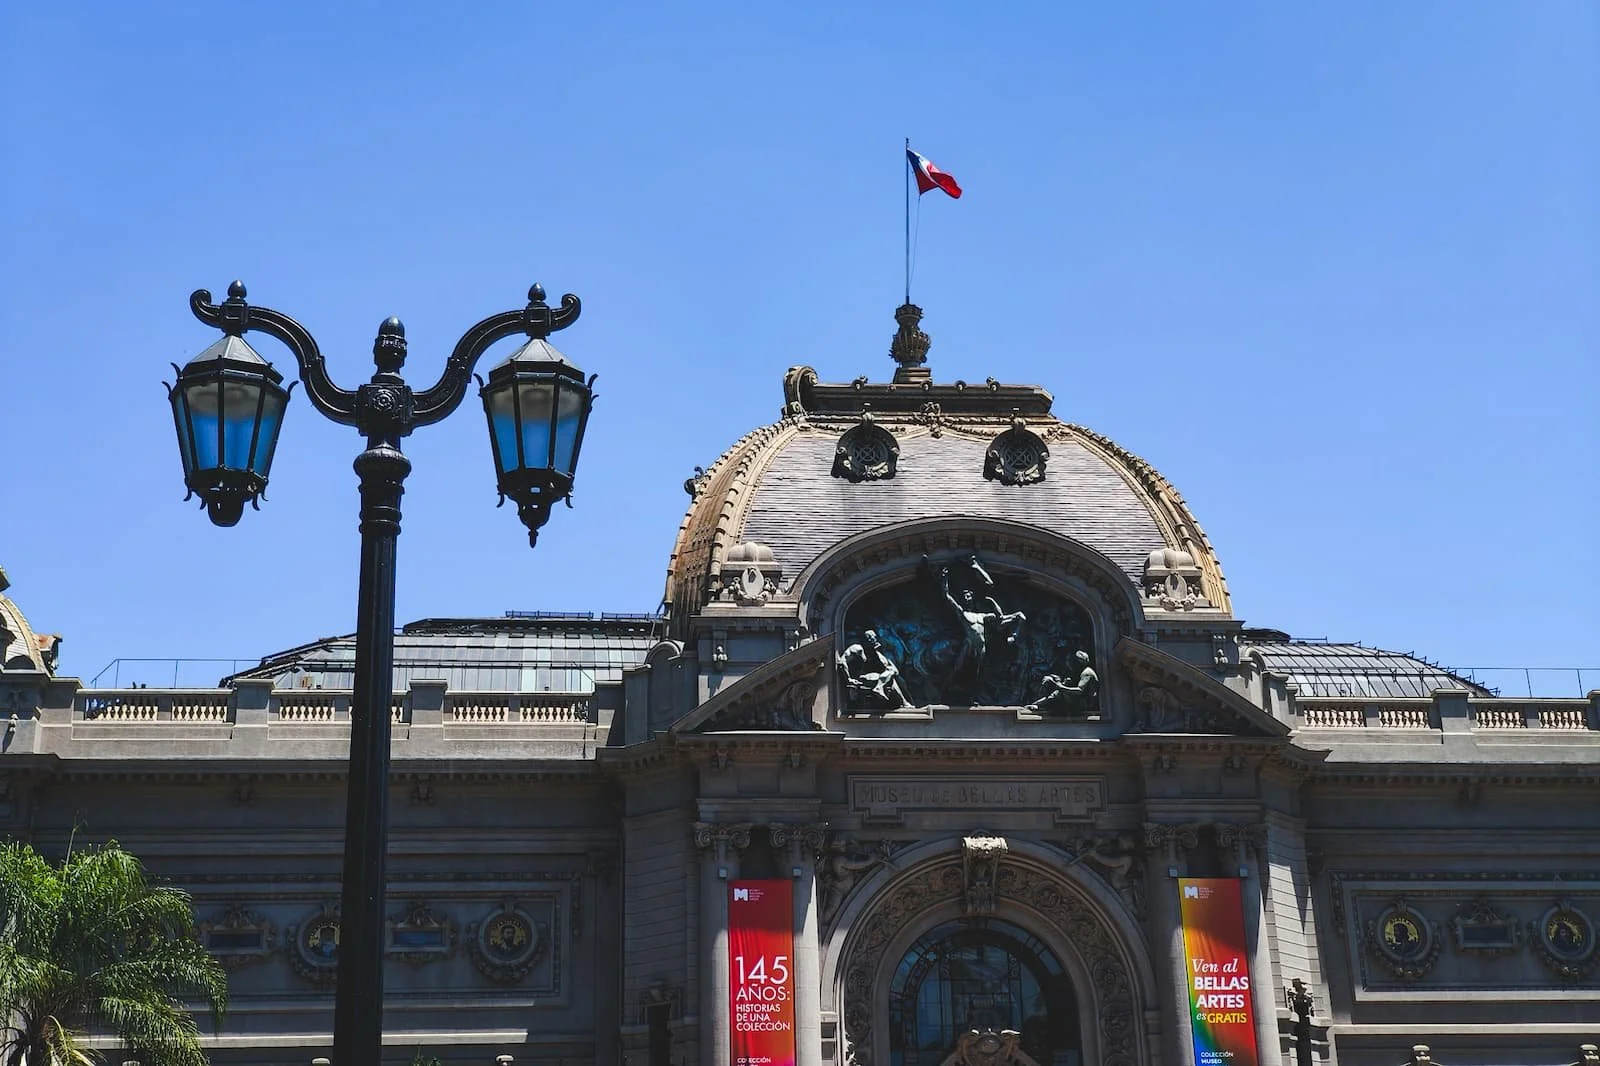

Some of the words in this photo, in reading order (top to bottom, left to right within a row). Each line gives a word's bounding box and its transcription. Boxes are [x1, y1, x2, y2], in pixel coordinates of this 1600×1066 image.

[862, 784, 923, 803] MUSEO
[1038, 784, 1096, 803] ARTES
[735, 954, 788, 985] 145
[1192, 958, 1219, 973] Ven
[1222, 958, 1239, 973] al
[1194, 976, 1249, 991] BELLAS
[735, 983, 791, 1001] AÑOS:
[735, 1003, 781, 1013] HISTORIAS
[1195, 994, 1245, 1009] ARTES
[736, 1013, 748, 1022] DE
[749, 1013, 771, 1022] UNA
[1207, 1012, 1248, 1024] GRATIS
[736, 1020, 791, 1032] COLECCIÓN
[736, 1056, 772, 1064] COECCIÓN
